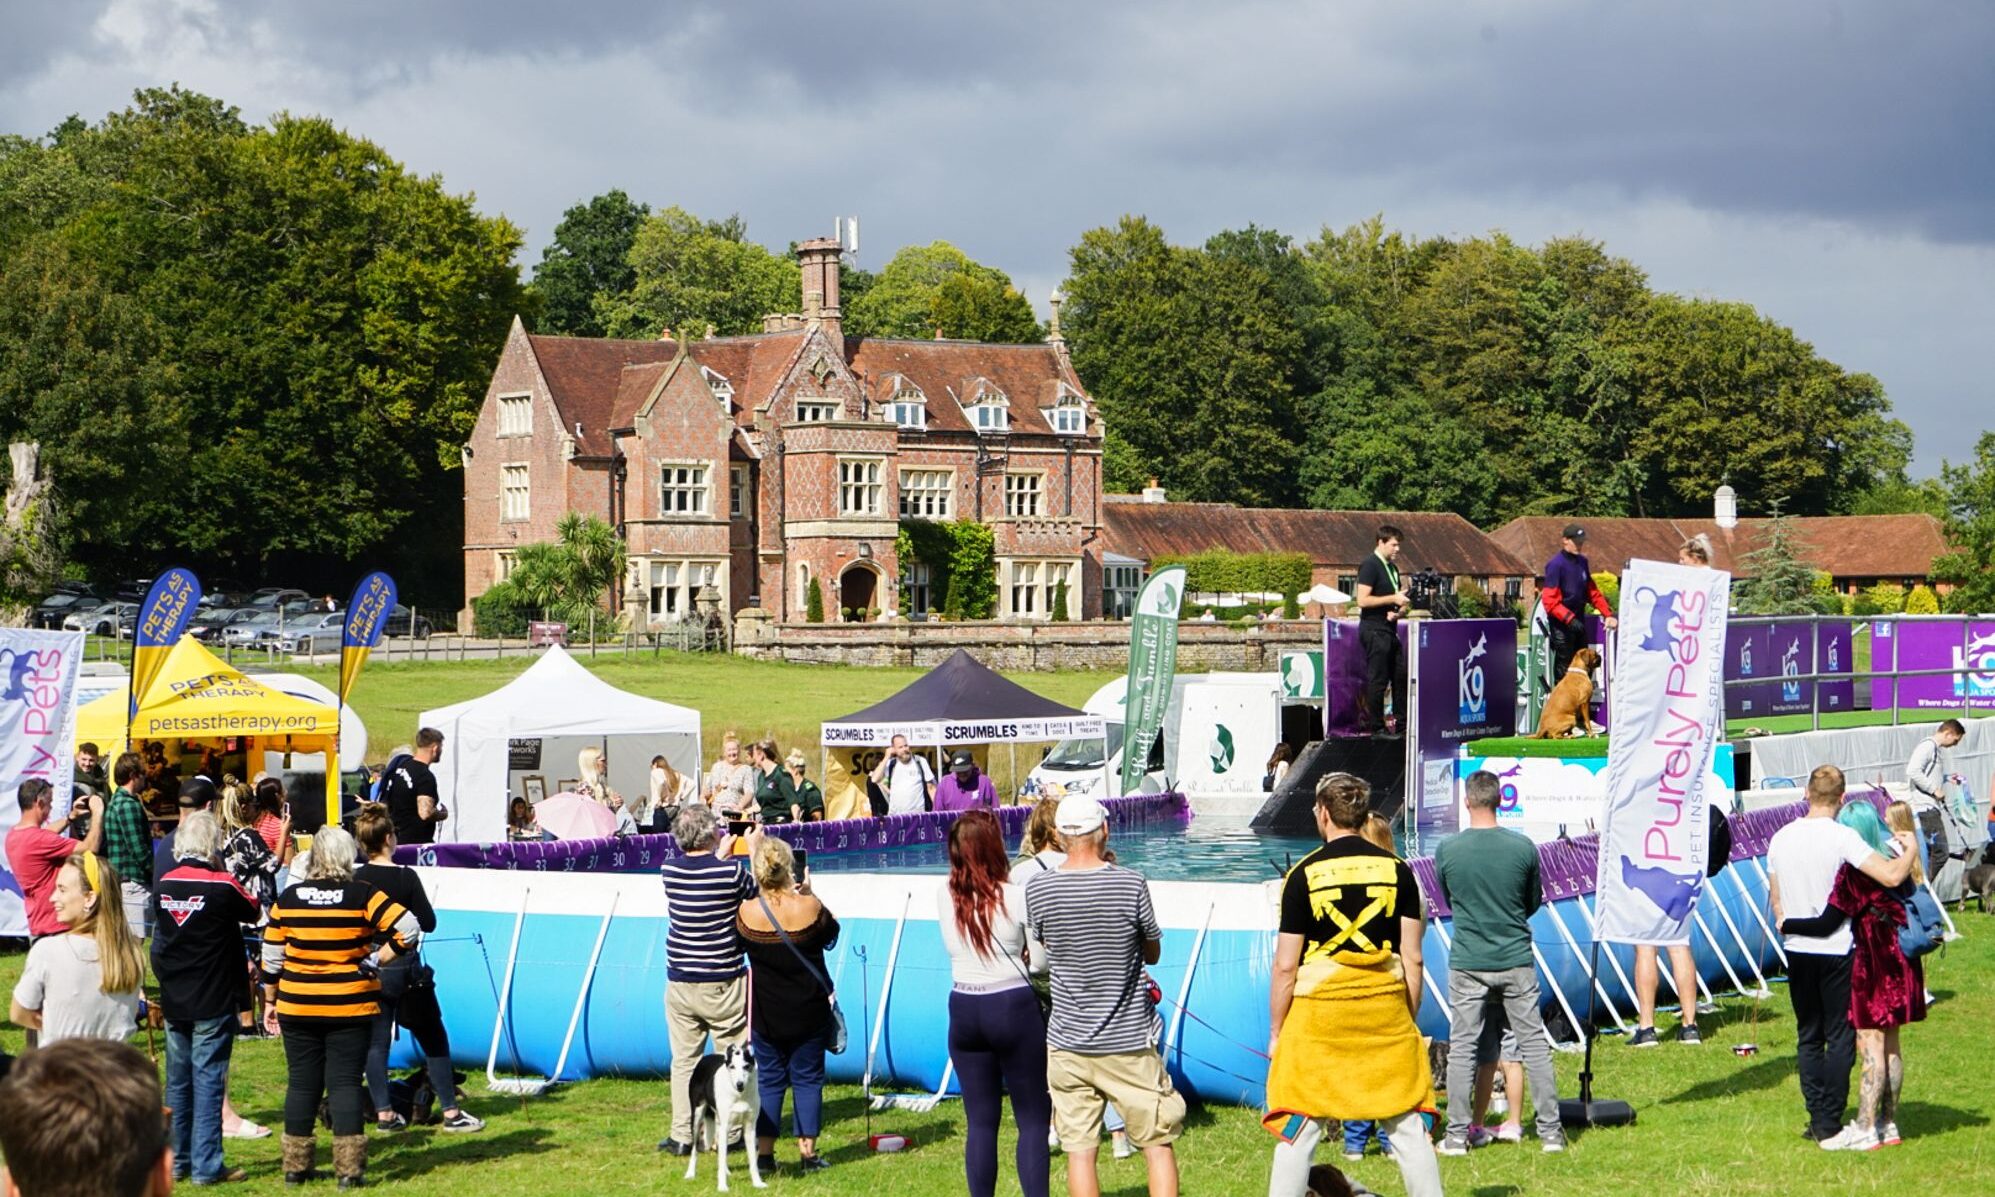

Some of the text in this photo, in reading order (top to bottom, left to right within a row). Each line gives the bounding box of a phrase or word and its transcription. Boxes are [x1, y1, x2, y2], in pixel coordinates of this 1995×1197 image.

[142, 571, 184, 637] PETS AS
[349, 575, 383, 635] PETS AS
[153, 581, 193, 645] THERAPY
[357, 585, 392, 645] THERAPY
[1164, 621, 1174, 647] COAT
[1136, 622, 1158, 691] Tumble
[170, 674, 234, 693] PETS
[24, 648, 63, 736] Pets
[179, 687, 265, 700] THERAPY
[1918, 699, 1941, 707] Where
[1942, 699, 1960, 708] Dogs
[1969, 699, 1991, 707] Water
[150, 714, 317, 734] petsastherapy.org
[945, 724, 1018, 739] SCRUMBLES
[1644, 589, 1707, 861] Purely Pets
[1690, 593, 1722, 865] PET INSURANCE SPECIALISTS
[825, 728, 874, 741] SCRUMBLES
[858, 833, 867, 846] 19
[878, 831, 887, 844] 18
[917, 827, 926, 840] 16
[935, 826, 943, 838] 15
[794, 838, 805, 850] 22
[837, 835, 848, 848] 20
[612, 852, 625, 867] 30
[640, 850, 650, 865] 29
[664, 848, 675, 860] 28
[535, 859, 547, 871] 33
[563, 857, 576, 871] 32
[587, 855, 599, 869] 31
